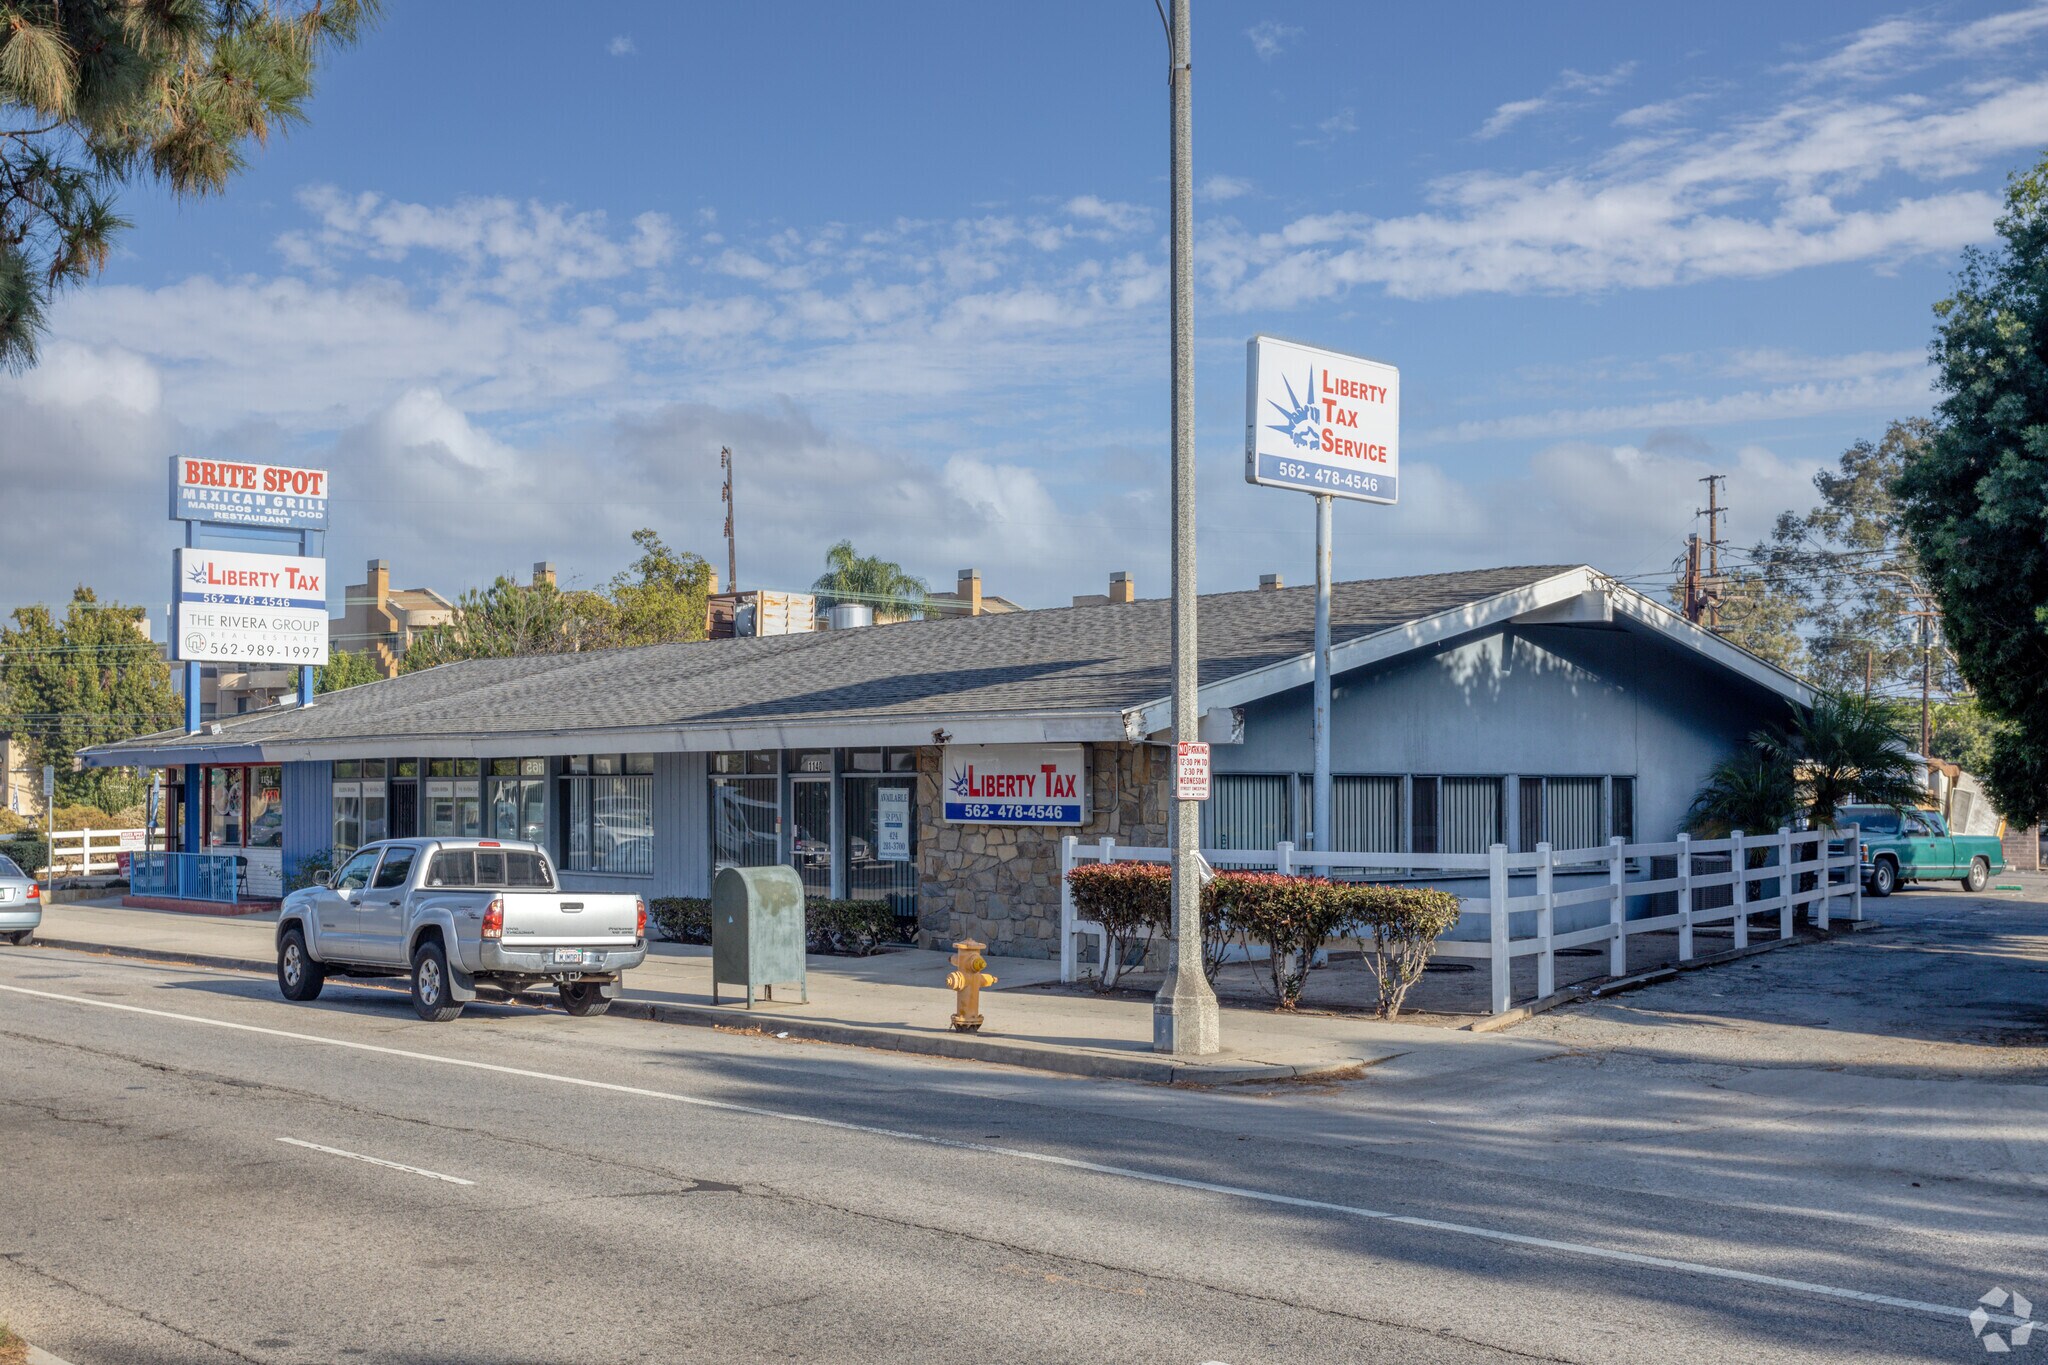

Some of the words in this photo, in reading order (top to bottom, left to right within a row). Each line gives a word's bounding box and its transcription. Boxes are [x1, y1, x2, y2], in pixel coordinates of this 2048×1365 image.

[1322, 369, 1387, 404] LIBERTY
[1322, 397, 1359, 429] TAX
[1321, 428, 1387, 463] SERVICE
[185, 460, 256, 490] BRITE
[263, 467, 323, 495] SPOT
[1279, 461, 1310, 481] 562-
[1315, 468, 1378, 492] 478-4546
[182, 488, 266, 506] MEXICAN
[274, 496, 325, 511] GRILL
[188, 501, 252, 513] MARISCOS
[265, 507, 288, 517] SEA
[291, 510, 324, 520] FOOD
[214, 511, 291, 525] RESTAURANT
[208, 562, 280, 588] LIBERTY
[285, 567, 319, 592] TAX
[234, 595, 291, 608] 478-4546
[189, 614, 215, 627] THE
[220, 615, 267, 630] RIVERA
[272, 618, 320, 632] GROUP
[211, 631, 247, 640] REAL
[263, 632, 318, 643] ESTATE
[210, 642, 320, 659] 562-989-1997
[1179, 744, 1188, 755] NO
[1188, 746, 1207, 755] PARKING
[808, 761, 823, 771] 1140
[968, 765, 1036, 797] LIBERTY
[1041, 764, 1077, 798] TAX
[1180, 777, 1207, 785] WEDNESDAY
[880, 794, 907, 802] AVAILABLE
[885, 812, 902, 822] RPM
[965, 804, 994, 818] 562-
[998, 805, 1063, 819] 478-4546
